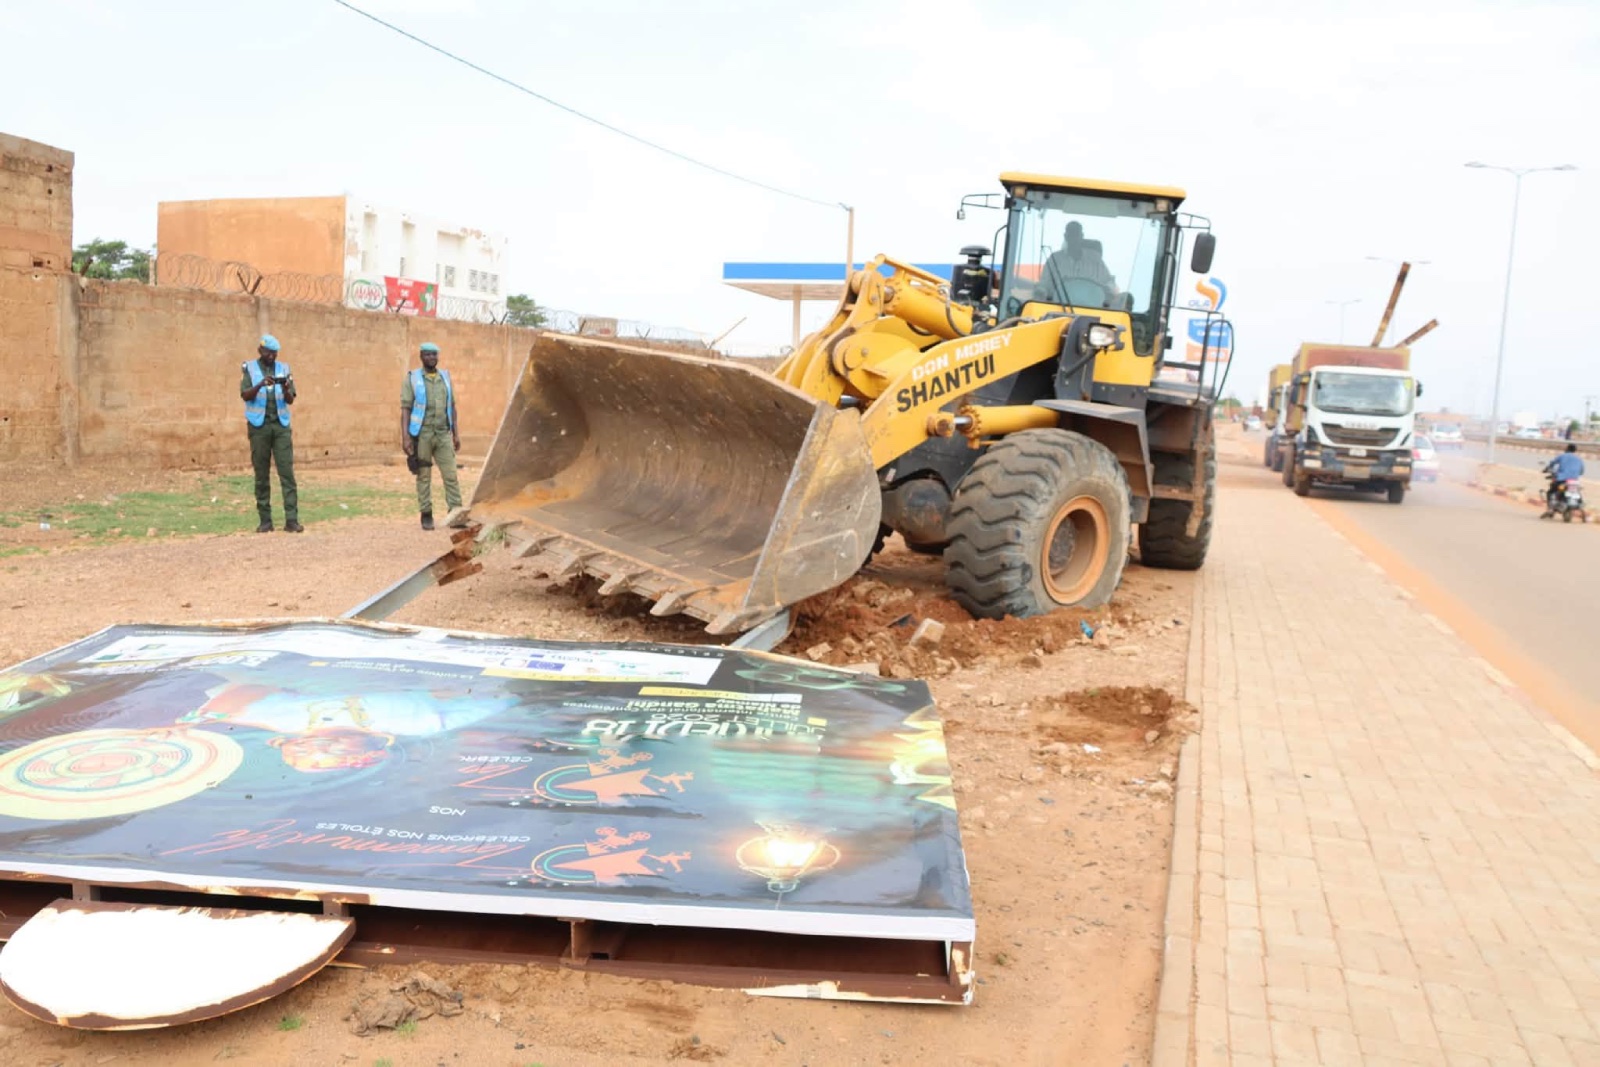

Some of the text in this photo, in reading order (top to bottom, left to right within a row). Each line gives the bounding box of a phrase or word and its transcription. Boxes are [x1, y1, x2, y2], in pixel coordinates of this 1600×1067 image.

[896, 354, 995, 413] SHANTUI
[627, 700, 800, 715] Mahatma Gandhi
[716, 698, 776, 708] Niamey
[727, 714, 824, 735] JUILLET
[429, 805, 466, 817] NOS
[315, 822, 531, 843] CÉLÉBRONS NOS ÉTOILES
